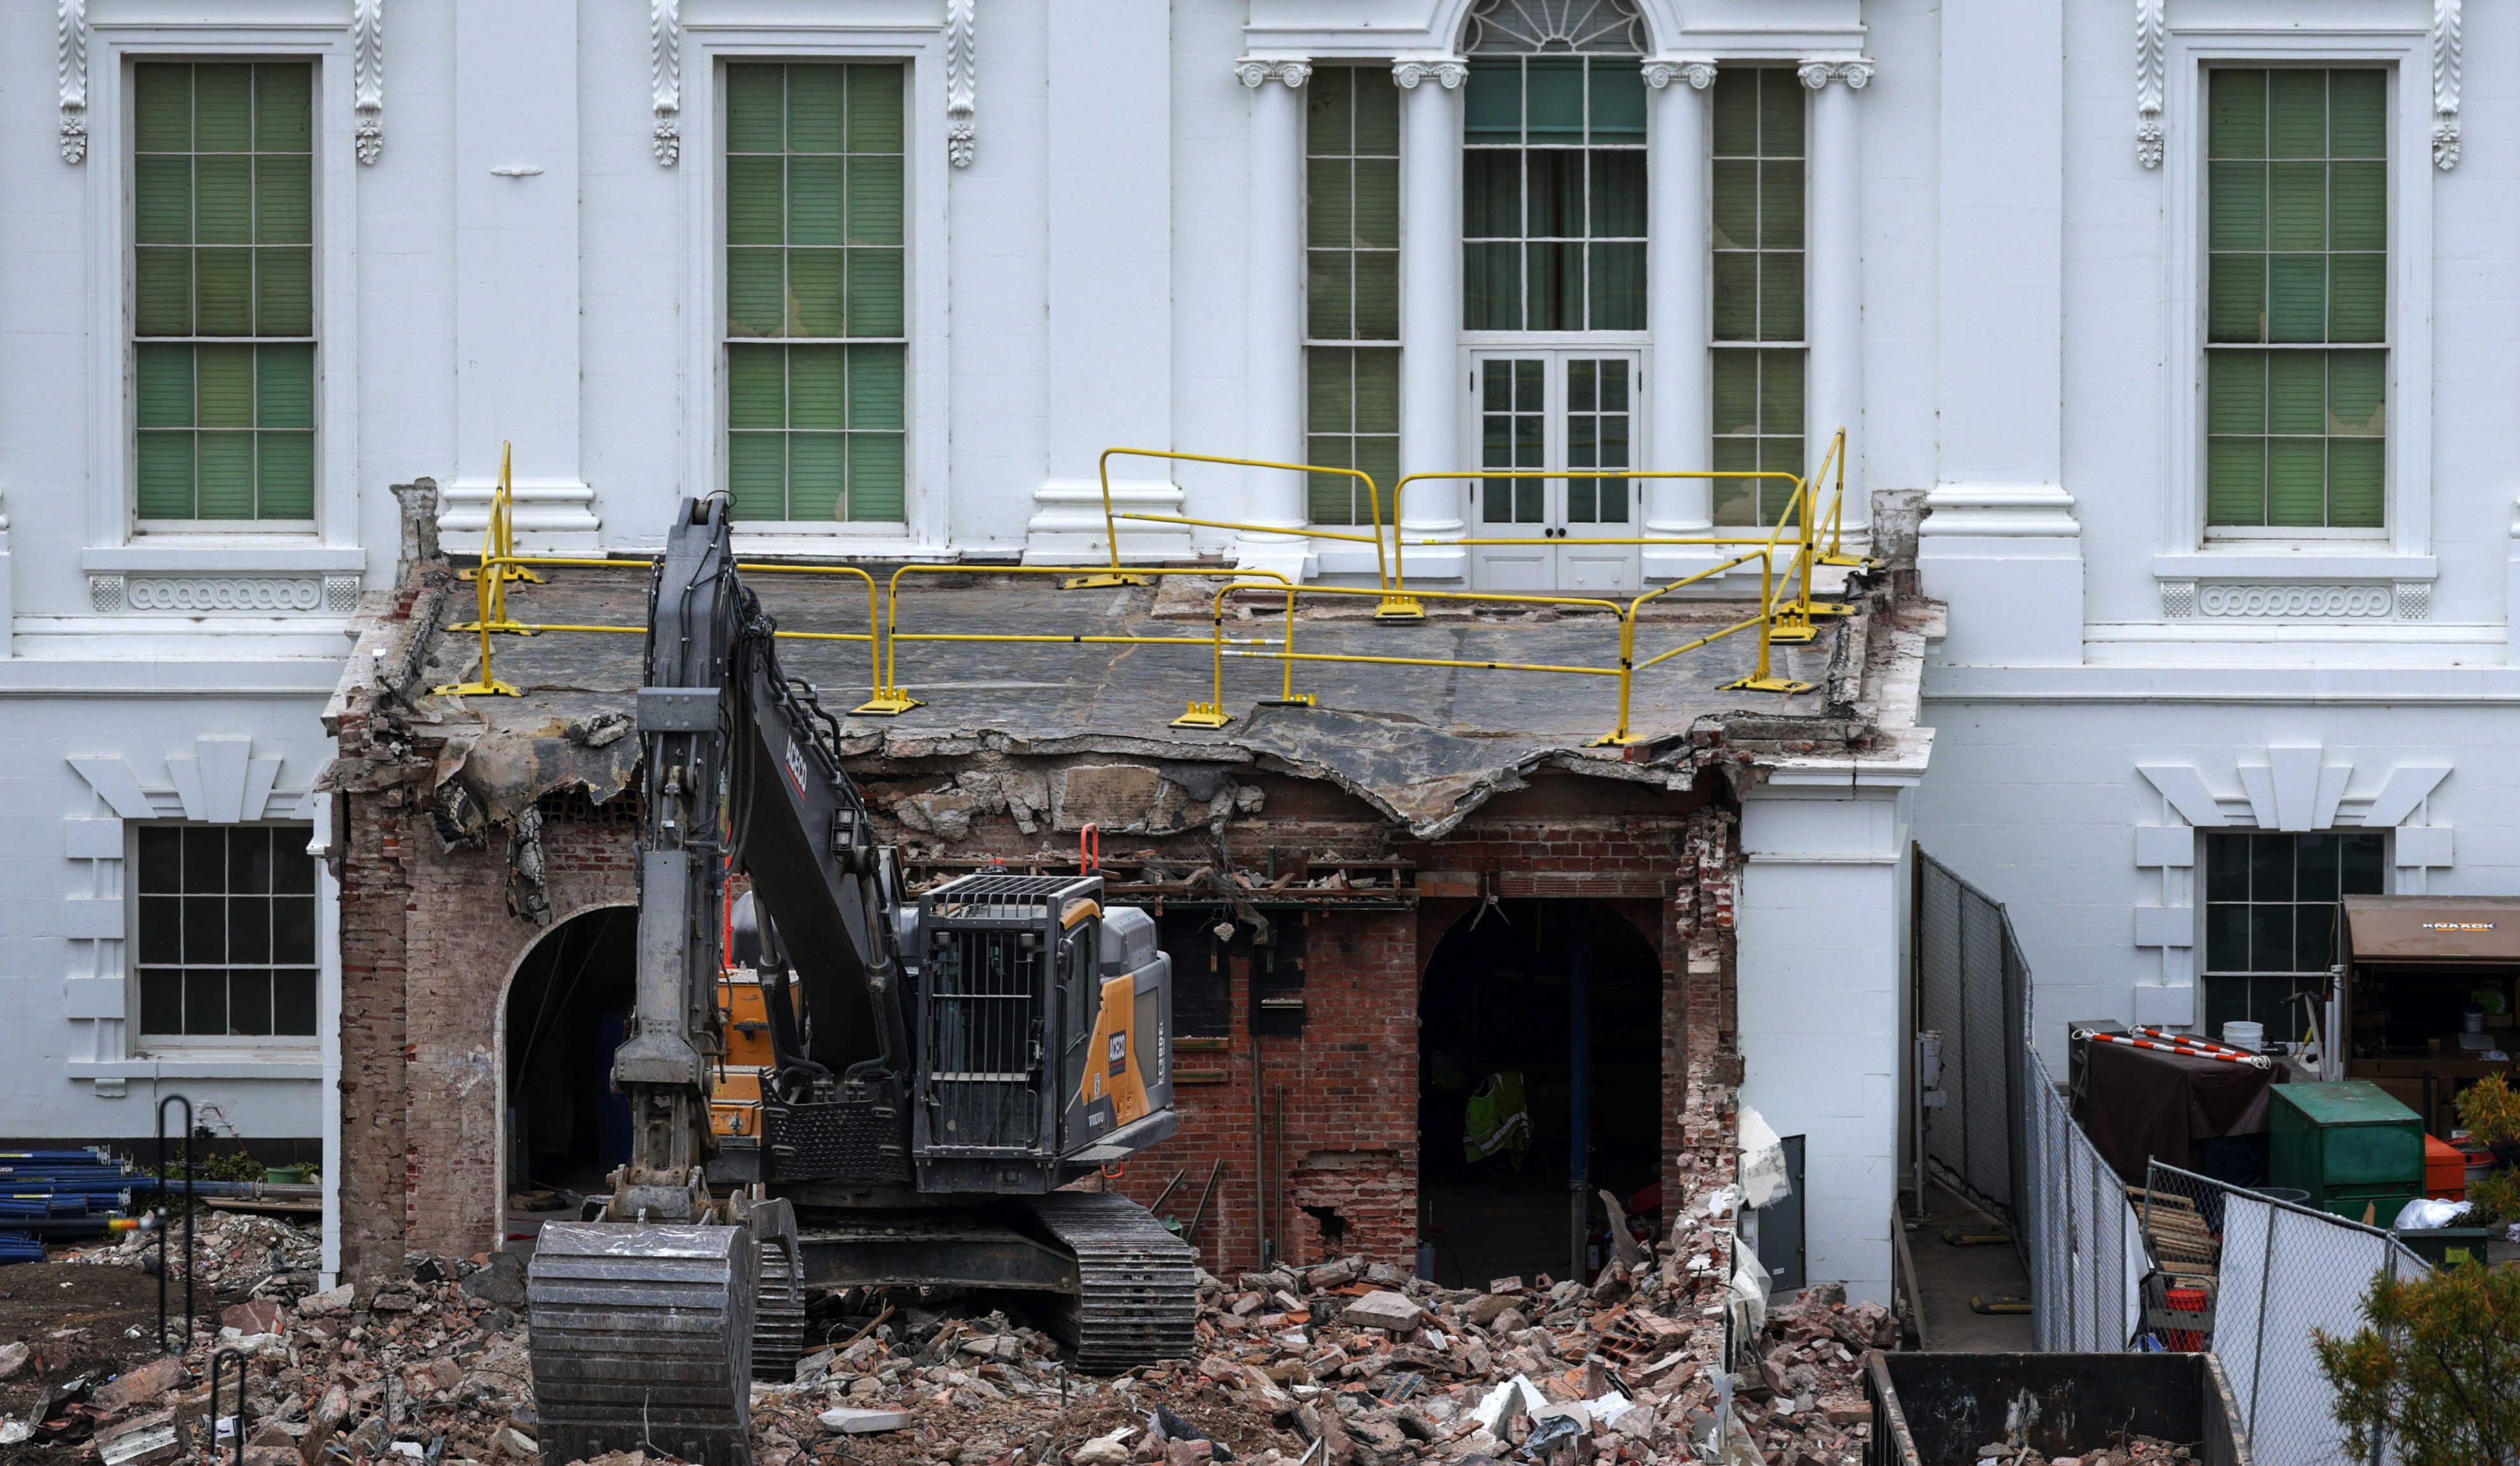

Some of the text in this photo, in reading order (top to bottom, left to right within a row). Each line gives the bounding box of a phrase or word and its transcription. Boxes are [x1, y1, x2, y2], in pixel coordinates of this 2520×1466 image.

[786, 734, 807, 792] ACECO
[1109, 1034, 1126, 1062] ACECO
[1089, 1111, 1104, 1127] VOLVO
